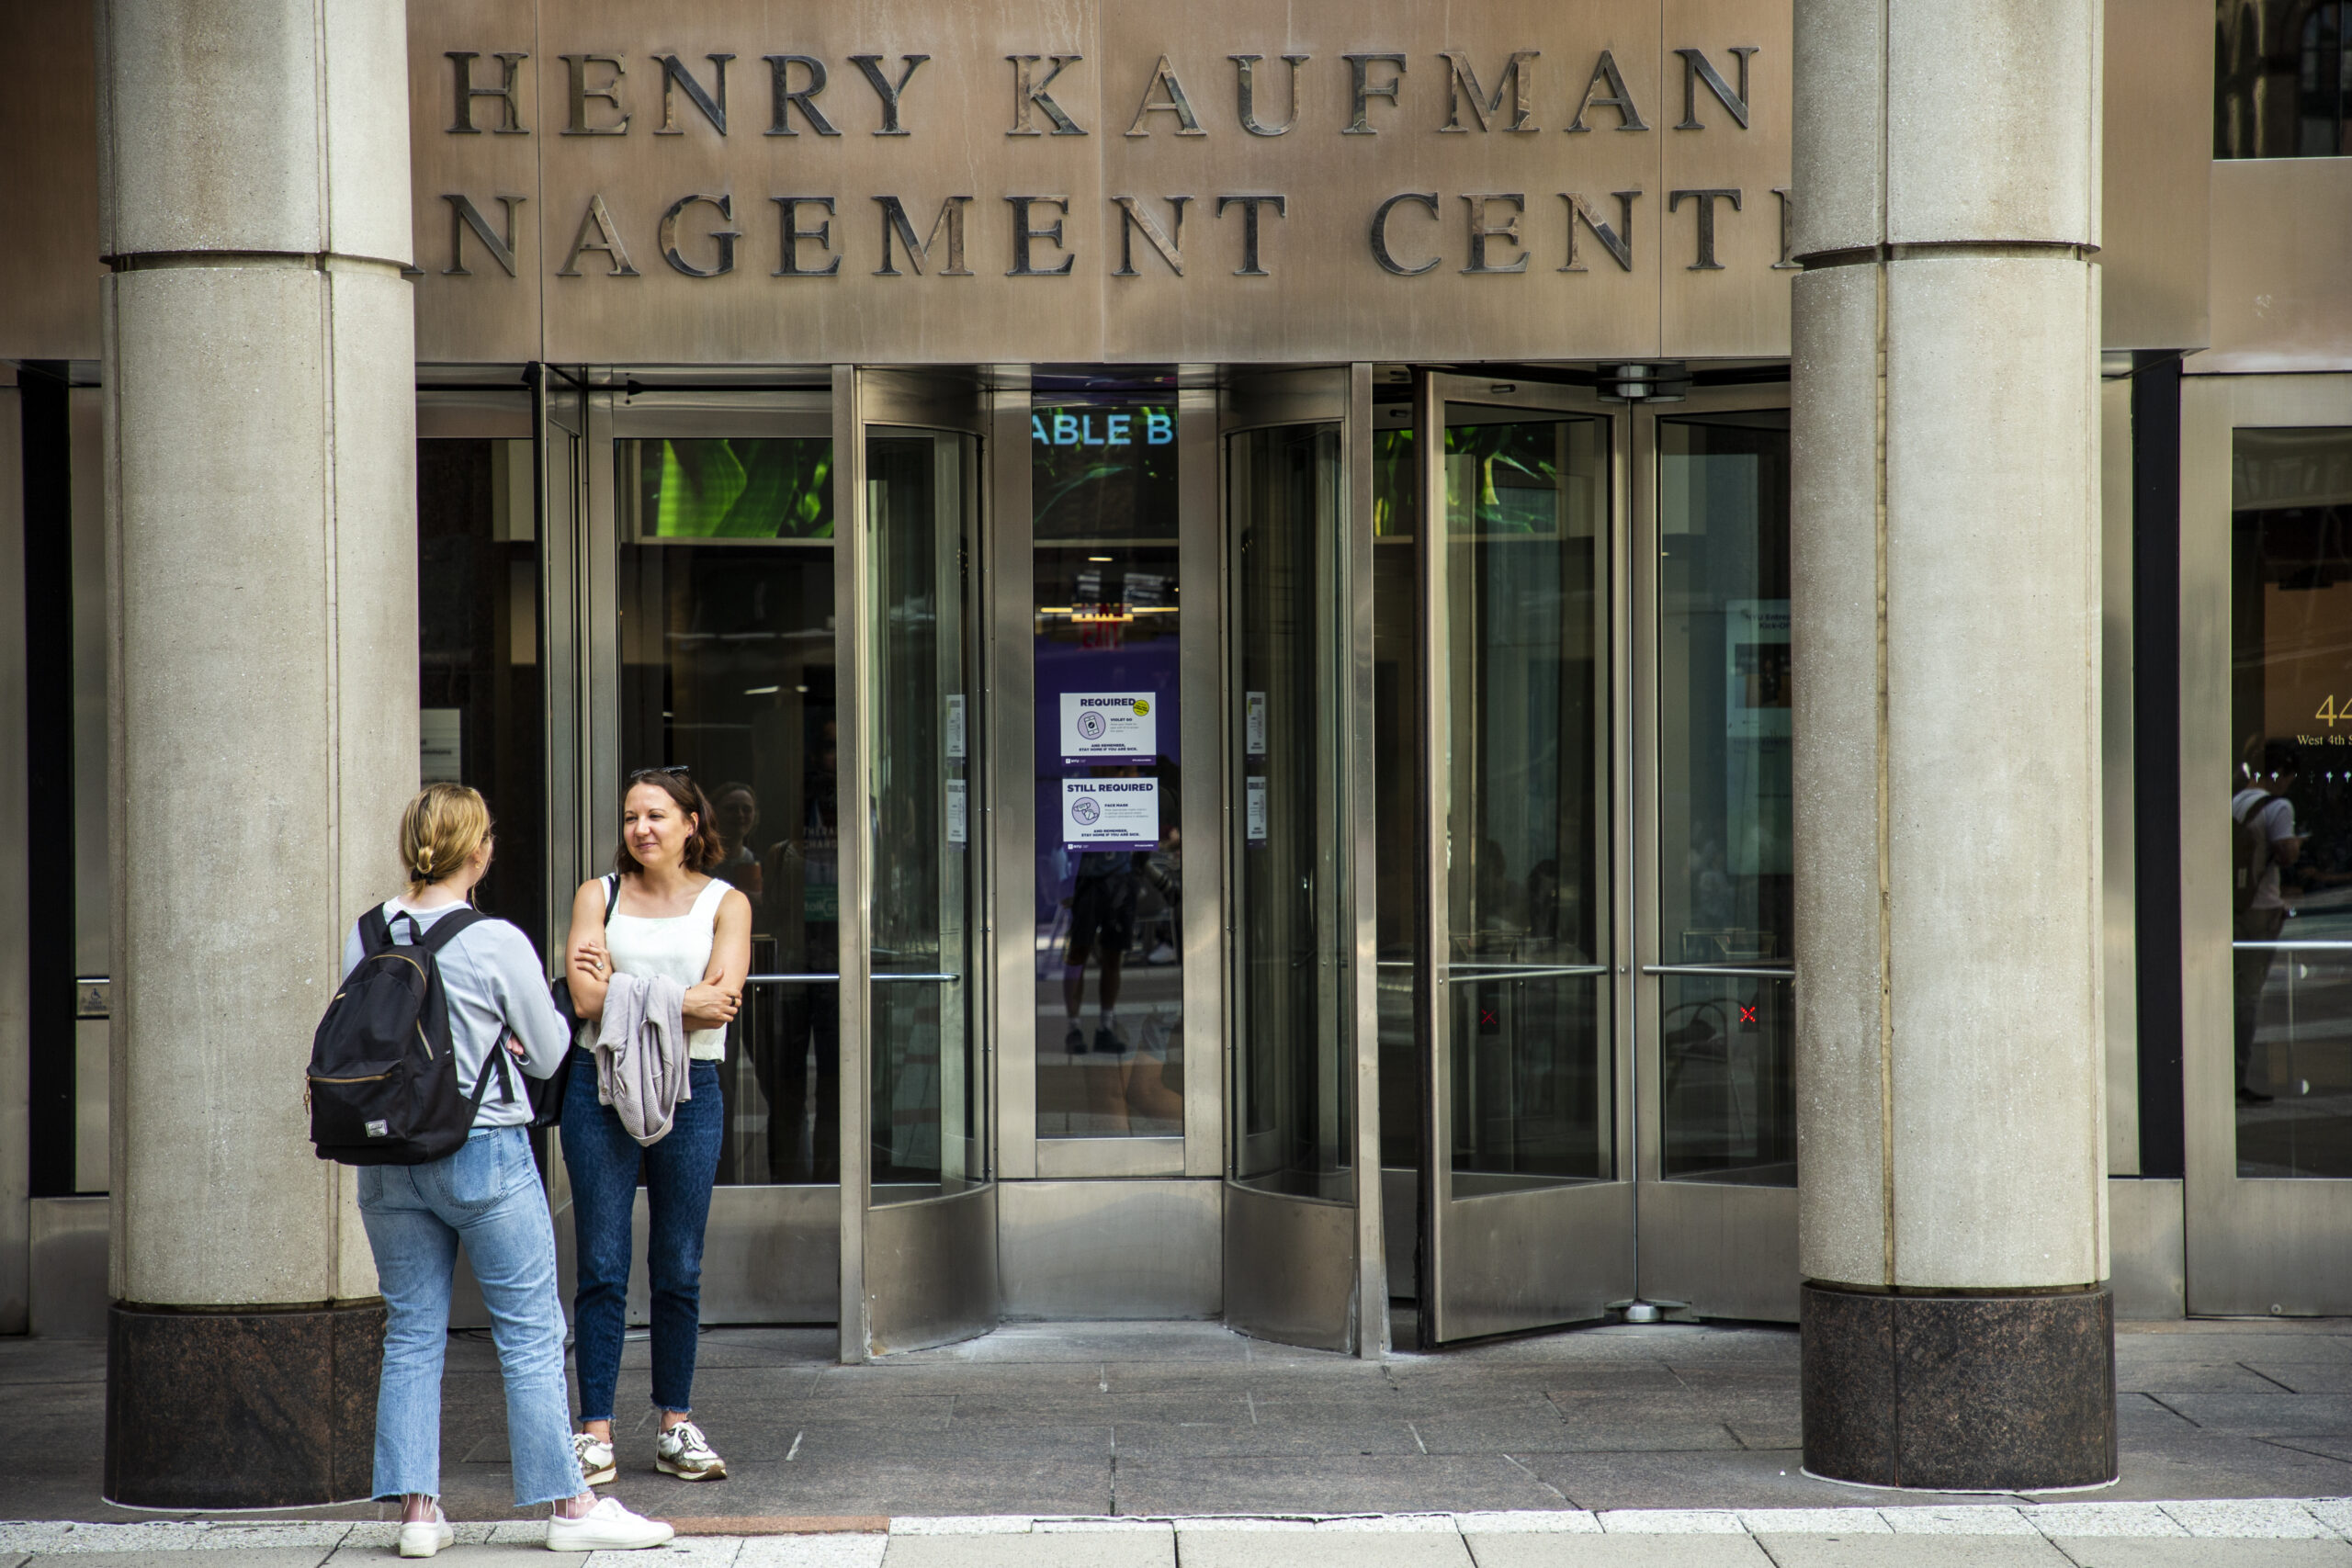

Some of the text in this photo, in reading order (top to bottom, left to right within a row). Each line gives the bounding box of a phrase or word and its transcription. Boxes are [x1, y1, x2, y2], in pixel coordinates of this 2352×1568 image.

[445, 46, 1760, 137] HENRY KAUFMAN
[407, 194, 1287, 277] NAGEMENT
[1032, 414, 1178, 446] ABLE B
[1080, 698, 1136, 706] REQUIRED
[2315, 694, 2352, 728] 44
[2297, 735, 2324, 746] West
[2327, 735, 2345, 746] 4th
[1067, 784, 1153, 793] STILL REQUIRED
